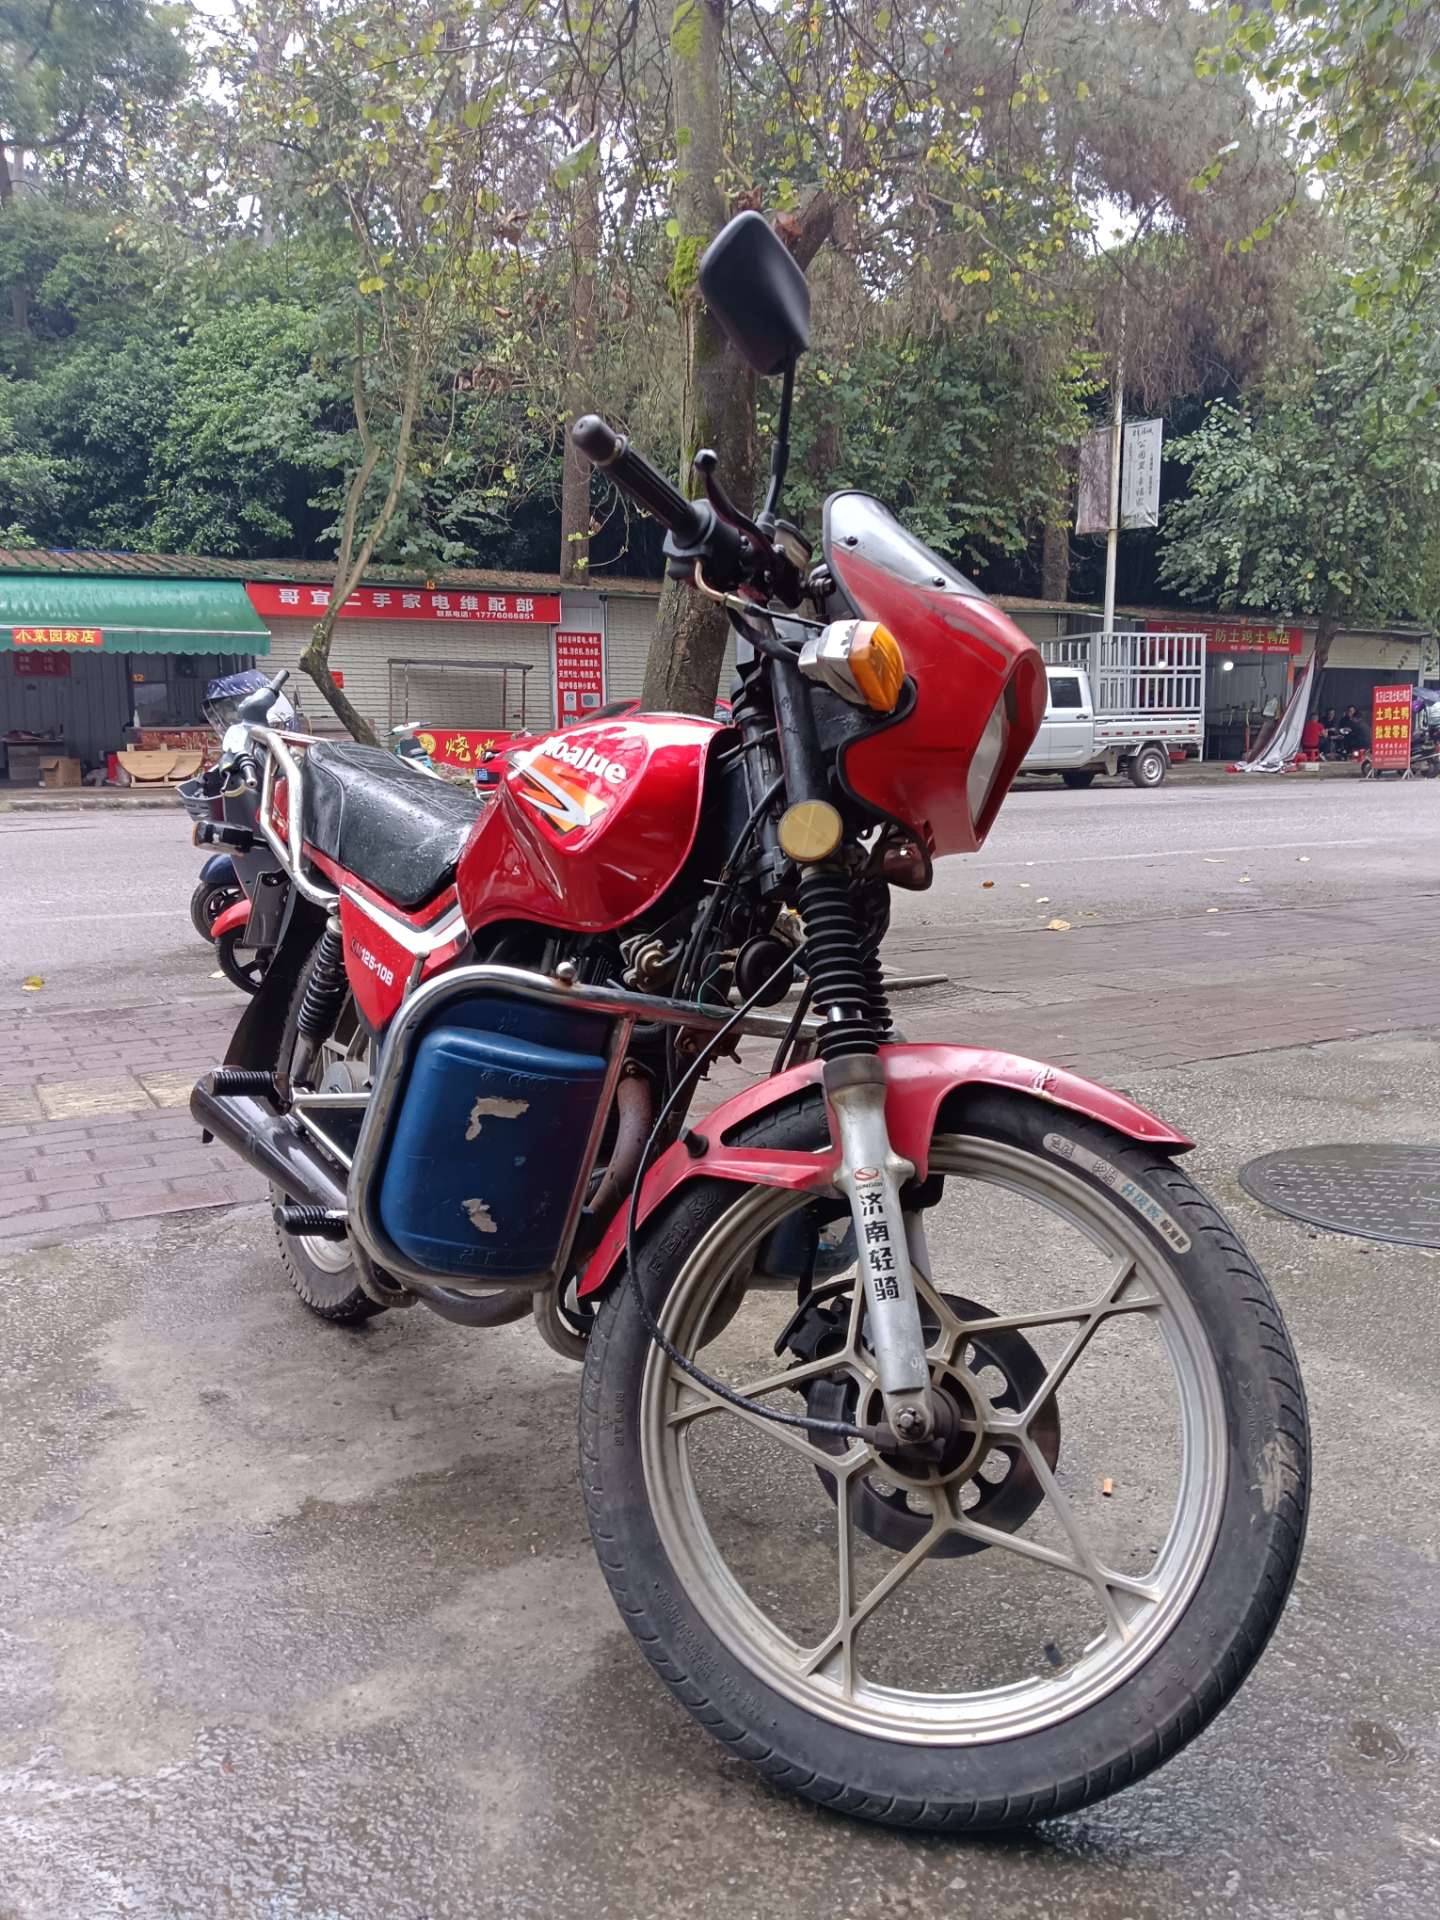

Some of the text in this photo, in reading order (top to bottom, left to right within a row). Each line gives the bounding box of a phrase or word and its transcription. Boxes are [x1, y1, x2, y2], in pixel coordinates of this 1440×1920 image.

[15, 629, 95, 643] 小菜园粉店
[860, 1192, 900, 1301] 济南轻骑
